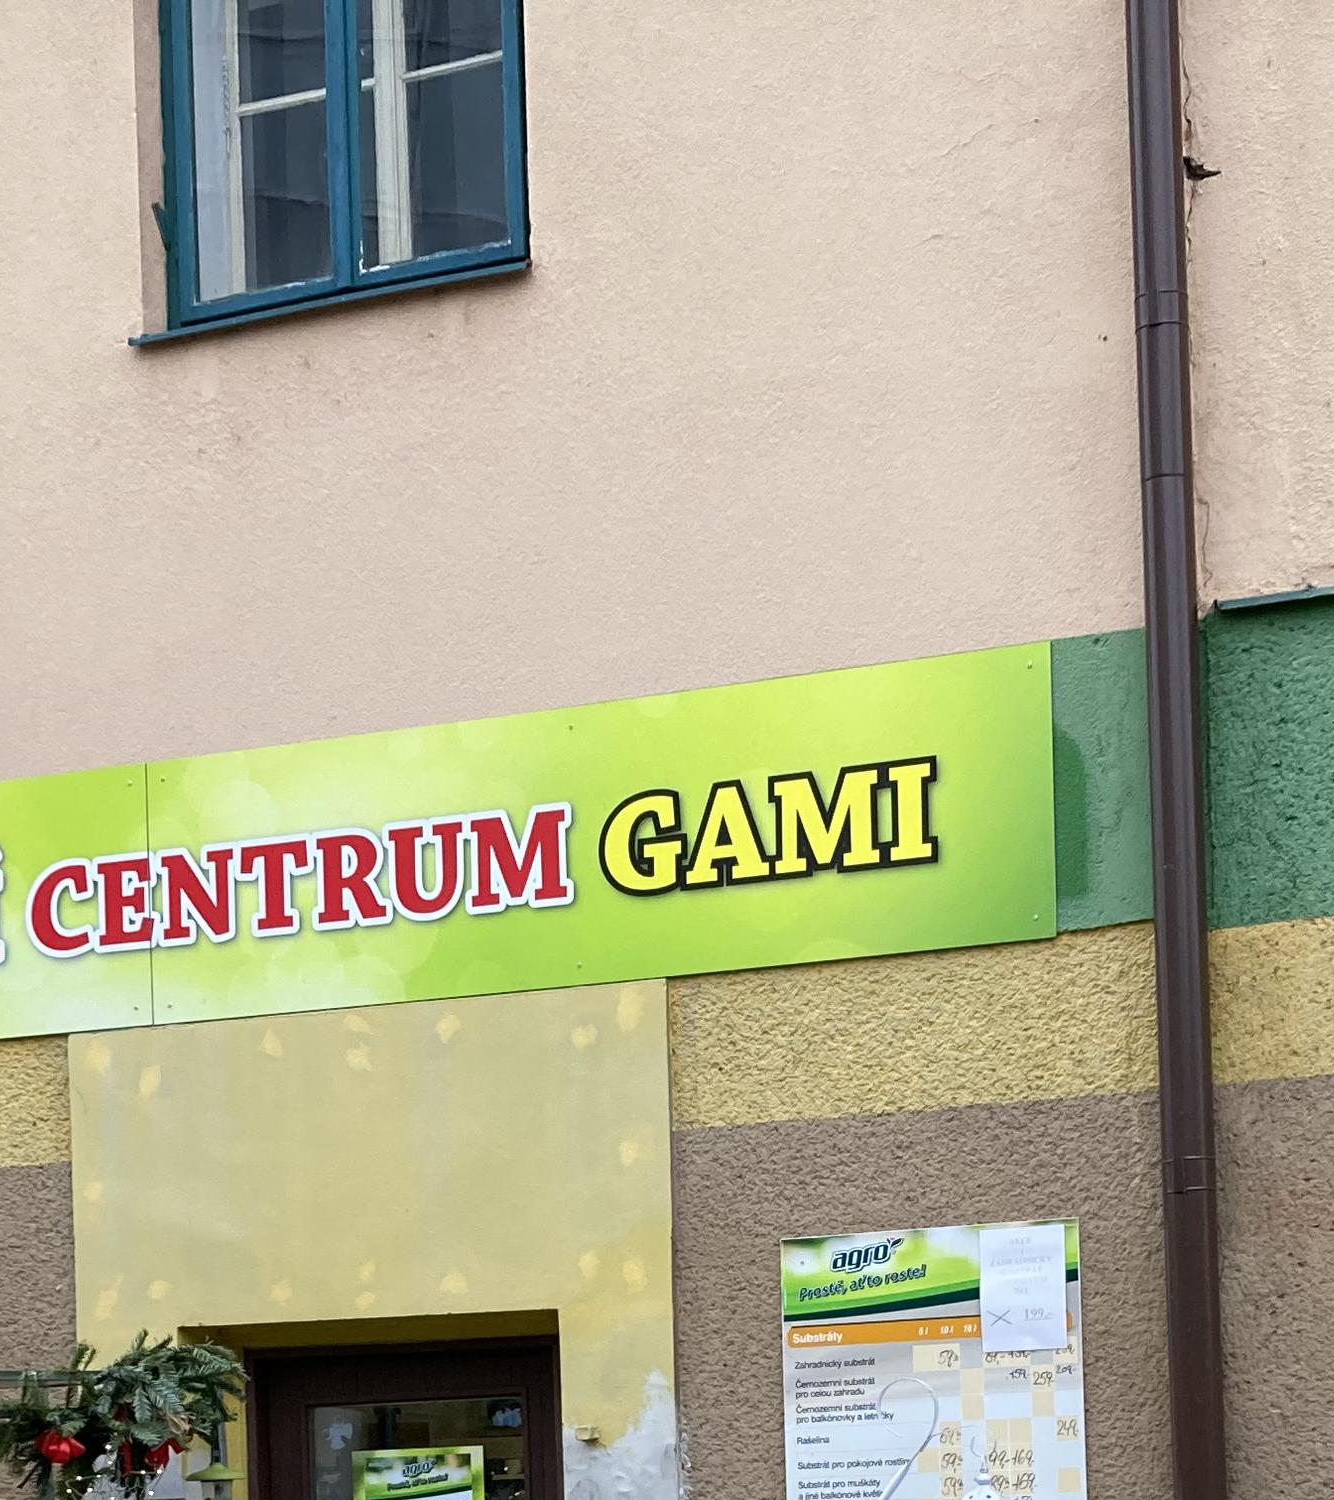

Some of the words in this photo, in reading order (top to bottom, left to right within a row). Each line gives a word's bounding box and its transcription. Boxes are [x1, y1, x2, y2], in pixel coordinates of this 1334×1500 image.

[29, 806, 571, 954] CENTRUM
[598, 756, 939, 896] GAMI
[832, 1242, 889, 1273] agro
[792, 1332, 843, 1344] Substráty
[795, 1359, 842, 1370] Zahradnický
[844, 1357, 875, 1366] substrát
[844, 1377, 875, 1386] substrát
[795, 1391, 809, 1400] pro
[810, 1389, 831, 1397] celou
[833, 1388, 865, 1396] zahradu
[844, 1403, 876, 1411] substrát
[796, 1416, 809, 1425] pro
[798, 1461, 829, 1470] Substrát
[832, 1461, 845, 1469] pro
[847, 1459, 883, 1469] pokojové
[798, 1481, 830, 1489] Substrát
[832, 1481, 845, 1489] pro
